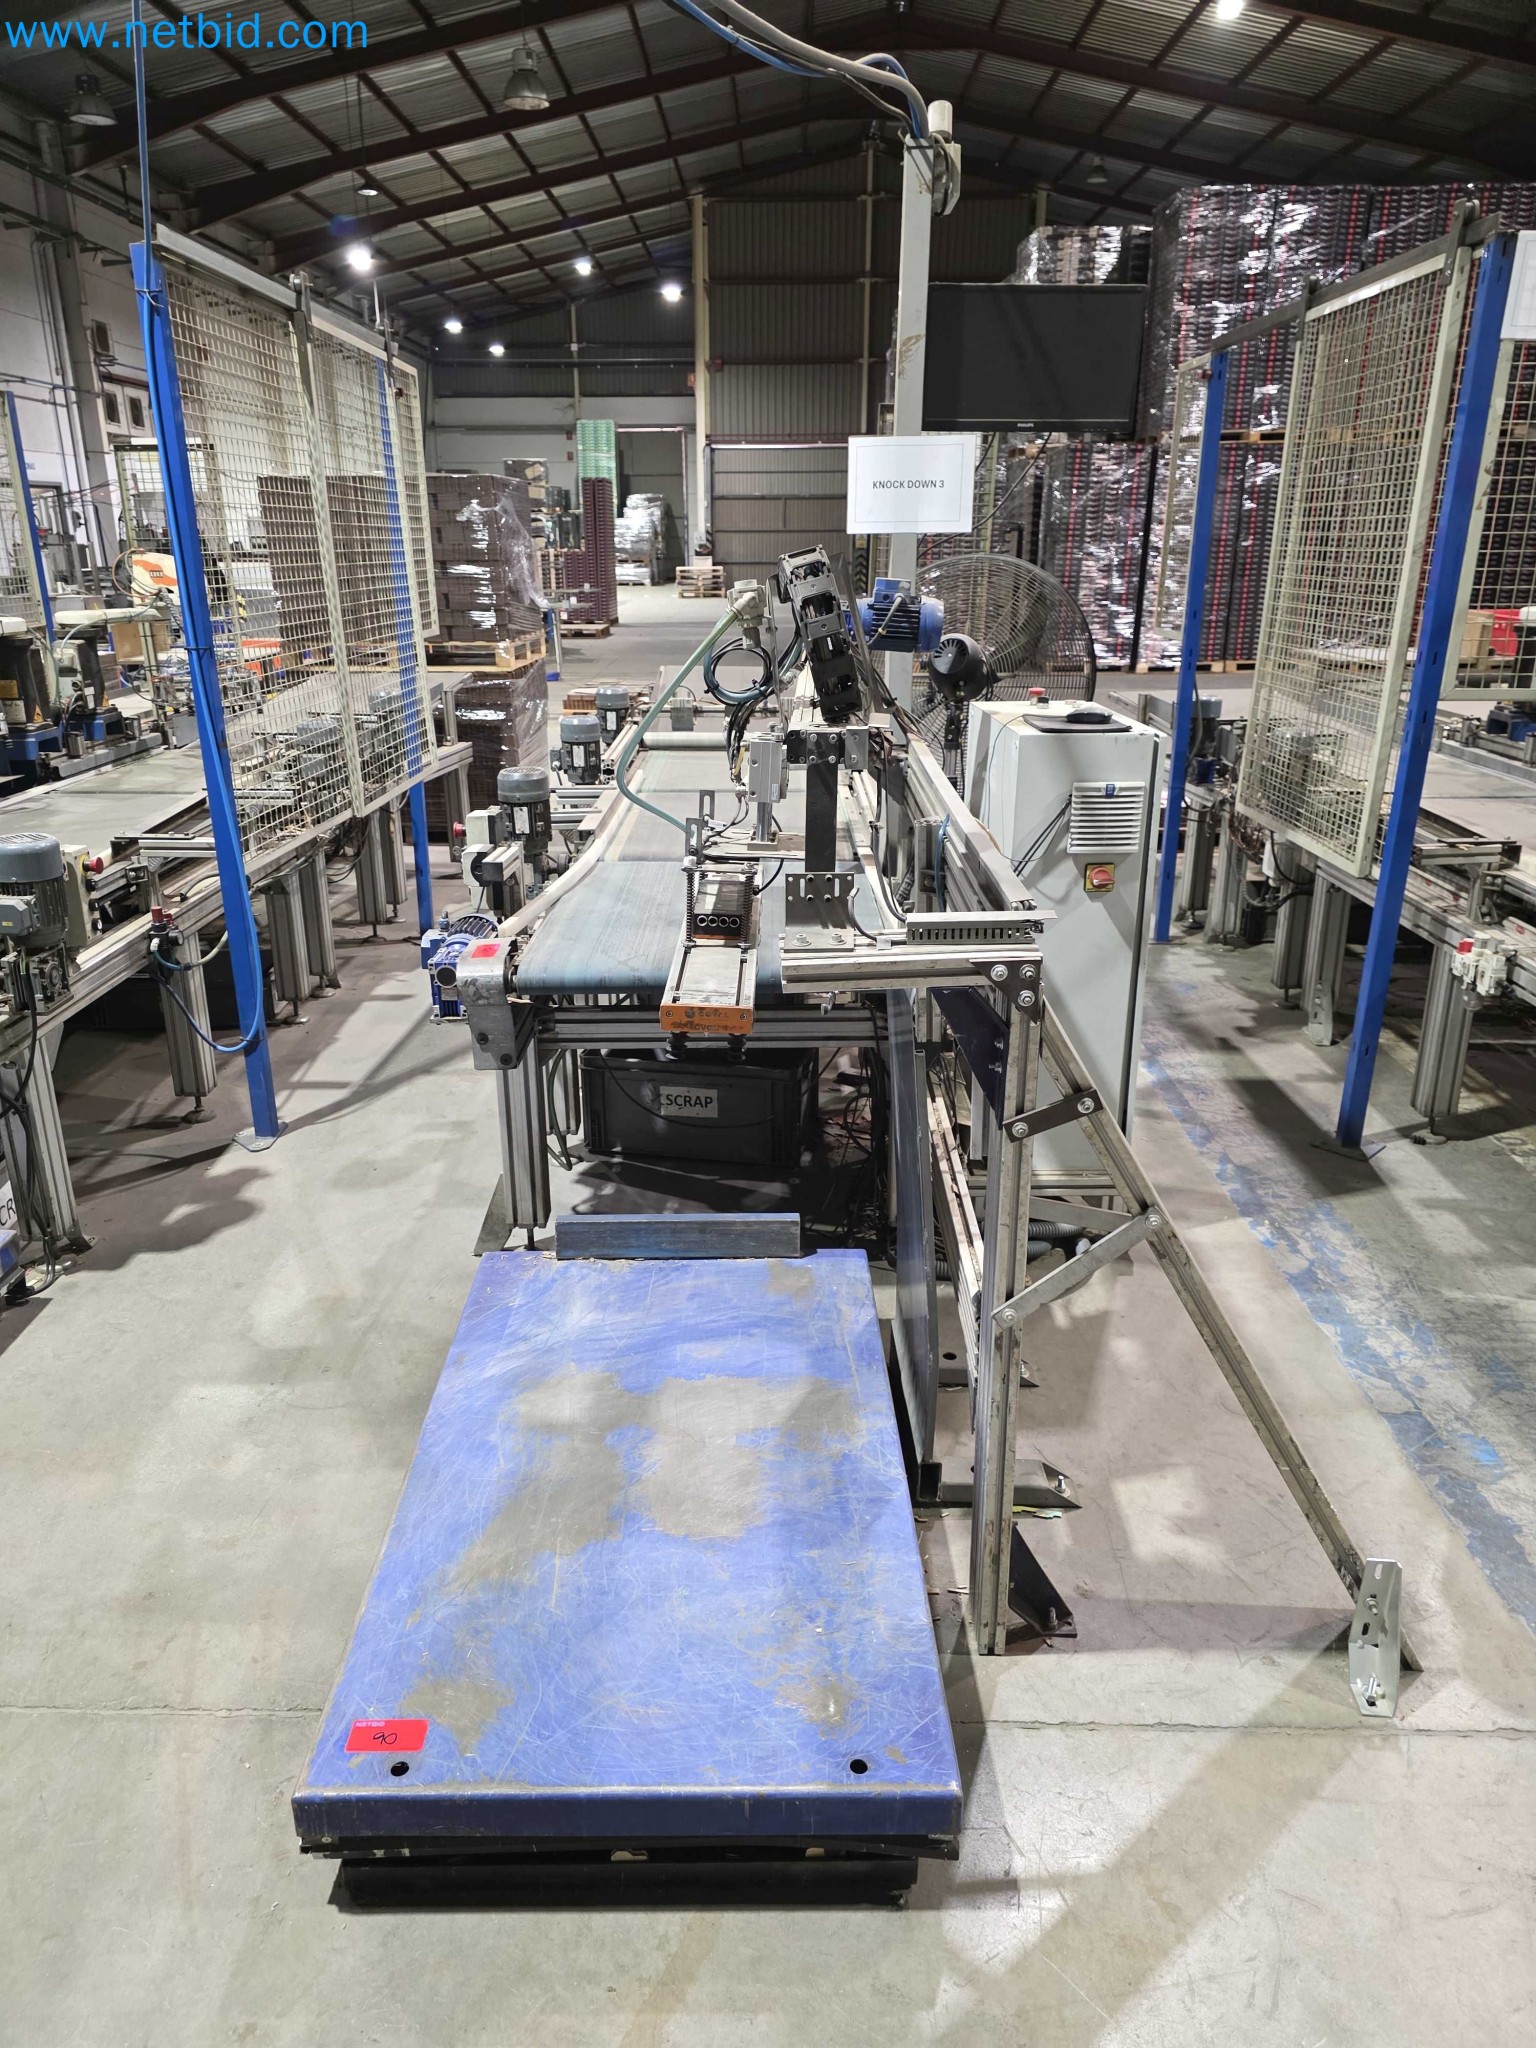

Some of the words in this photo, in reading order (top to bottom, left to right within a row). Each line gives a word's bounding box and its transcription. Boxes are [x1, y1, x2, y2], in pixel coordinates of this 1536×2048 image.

[872, 480, 906, 490] KNOCK
[907, 480, 937, 489] DOWN
[939, 480, 945, 489] 3
[665, 1094, 713, 1109] SCRAP
[373, 1731, 398, 1745] 90
